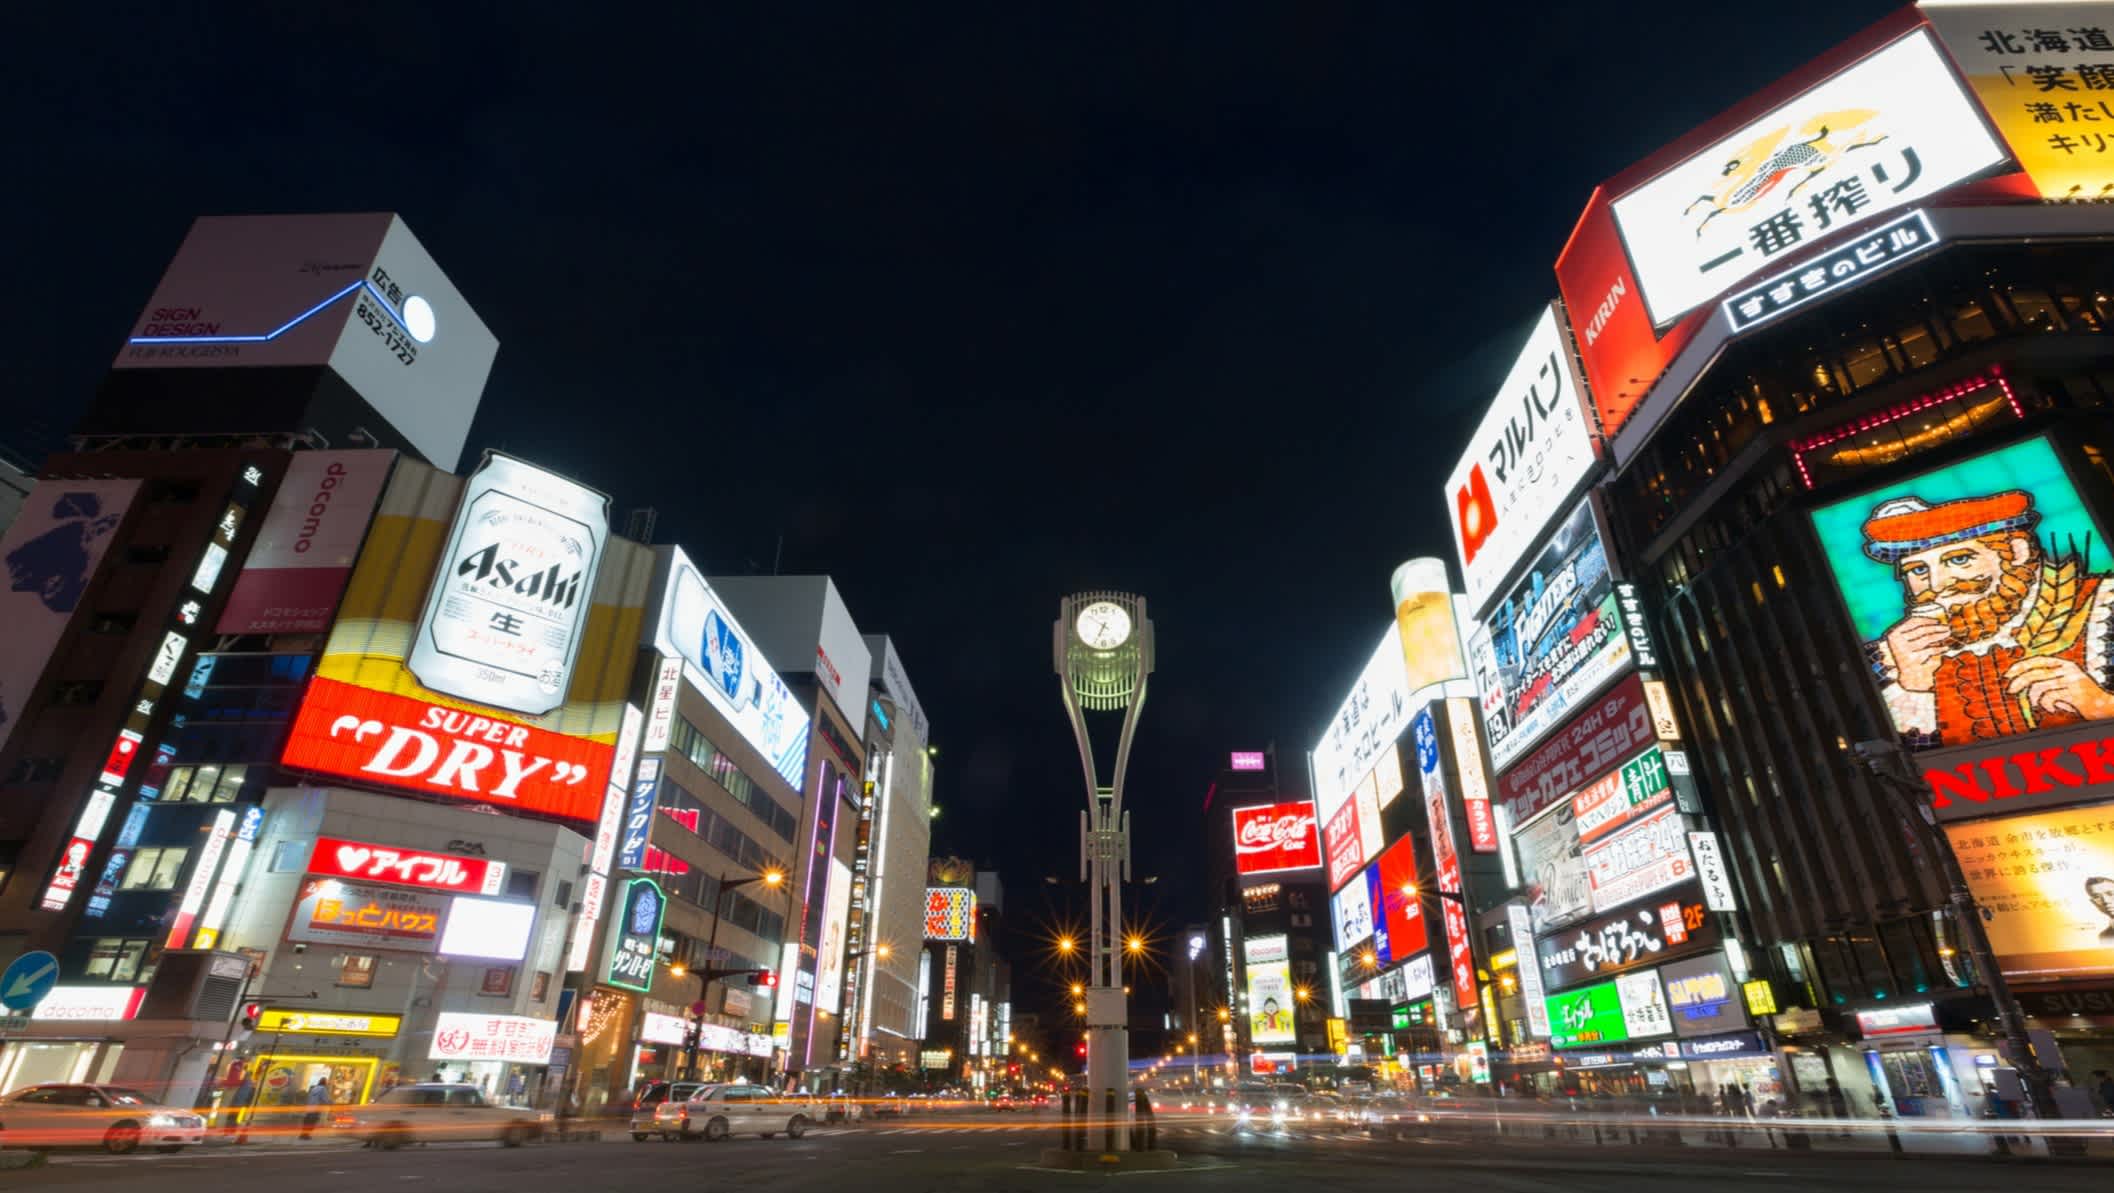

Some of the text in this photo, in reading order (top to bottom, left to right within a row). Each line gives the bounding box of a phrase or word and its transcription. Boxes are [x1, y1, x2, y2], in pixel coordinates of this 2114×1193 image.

[1978, 27, 2114, 54] 北海道
[2047, 133, 2114, 154] キリ
[1699, 146, 1922, 273] 一番搾り
[371, 266, 403, 306] 広告
[1739, 227, 1919, 320] すすきのビル
[142, 323, 221, 337] DESIGN
[151, 308, 202, 321] SIGN
[1584, 277, 1627, 346] KIRIN
[355, 303, 416, 368] 852-1727
[1488, 350, 1563, 484] マルハン
[294, 461, 347, 554] docomo
[457, 542, 582, 610] Asahi
[488, 611, 525, 637] 生
[650, 666, 678, 739] 北星ビル
[420, 706, 529, 748] SUPER
[1572, 713, 1604, 745] 24H
[1626, 753, 1663, 805] 青汁
[1241, 814, 1307, 845] Coca-Cola
[1954, 835, 2001, 850] 北海道
[368, 849, 469, 886] アイフル
[311, 898, 438, 933] ほっとハウス
[1683, 903, 1705, 930] 2F
